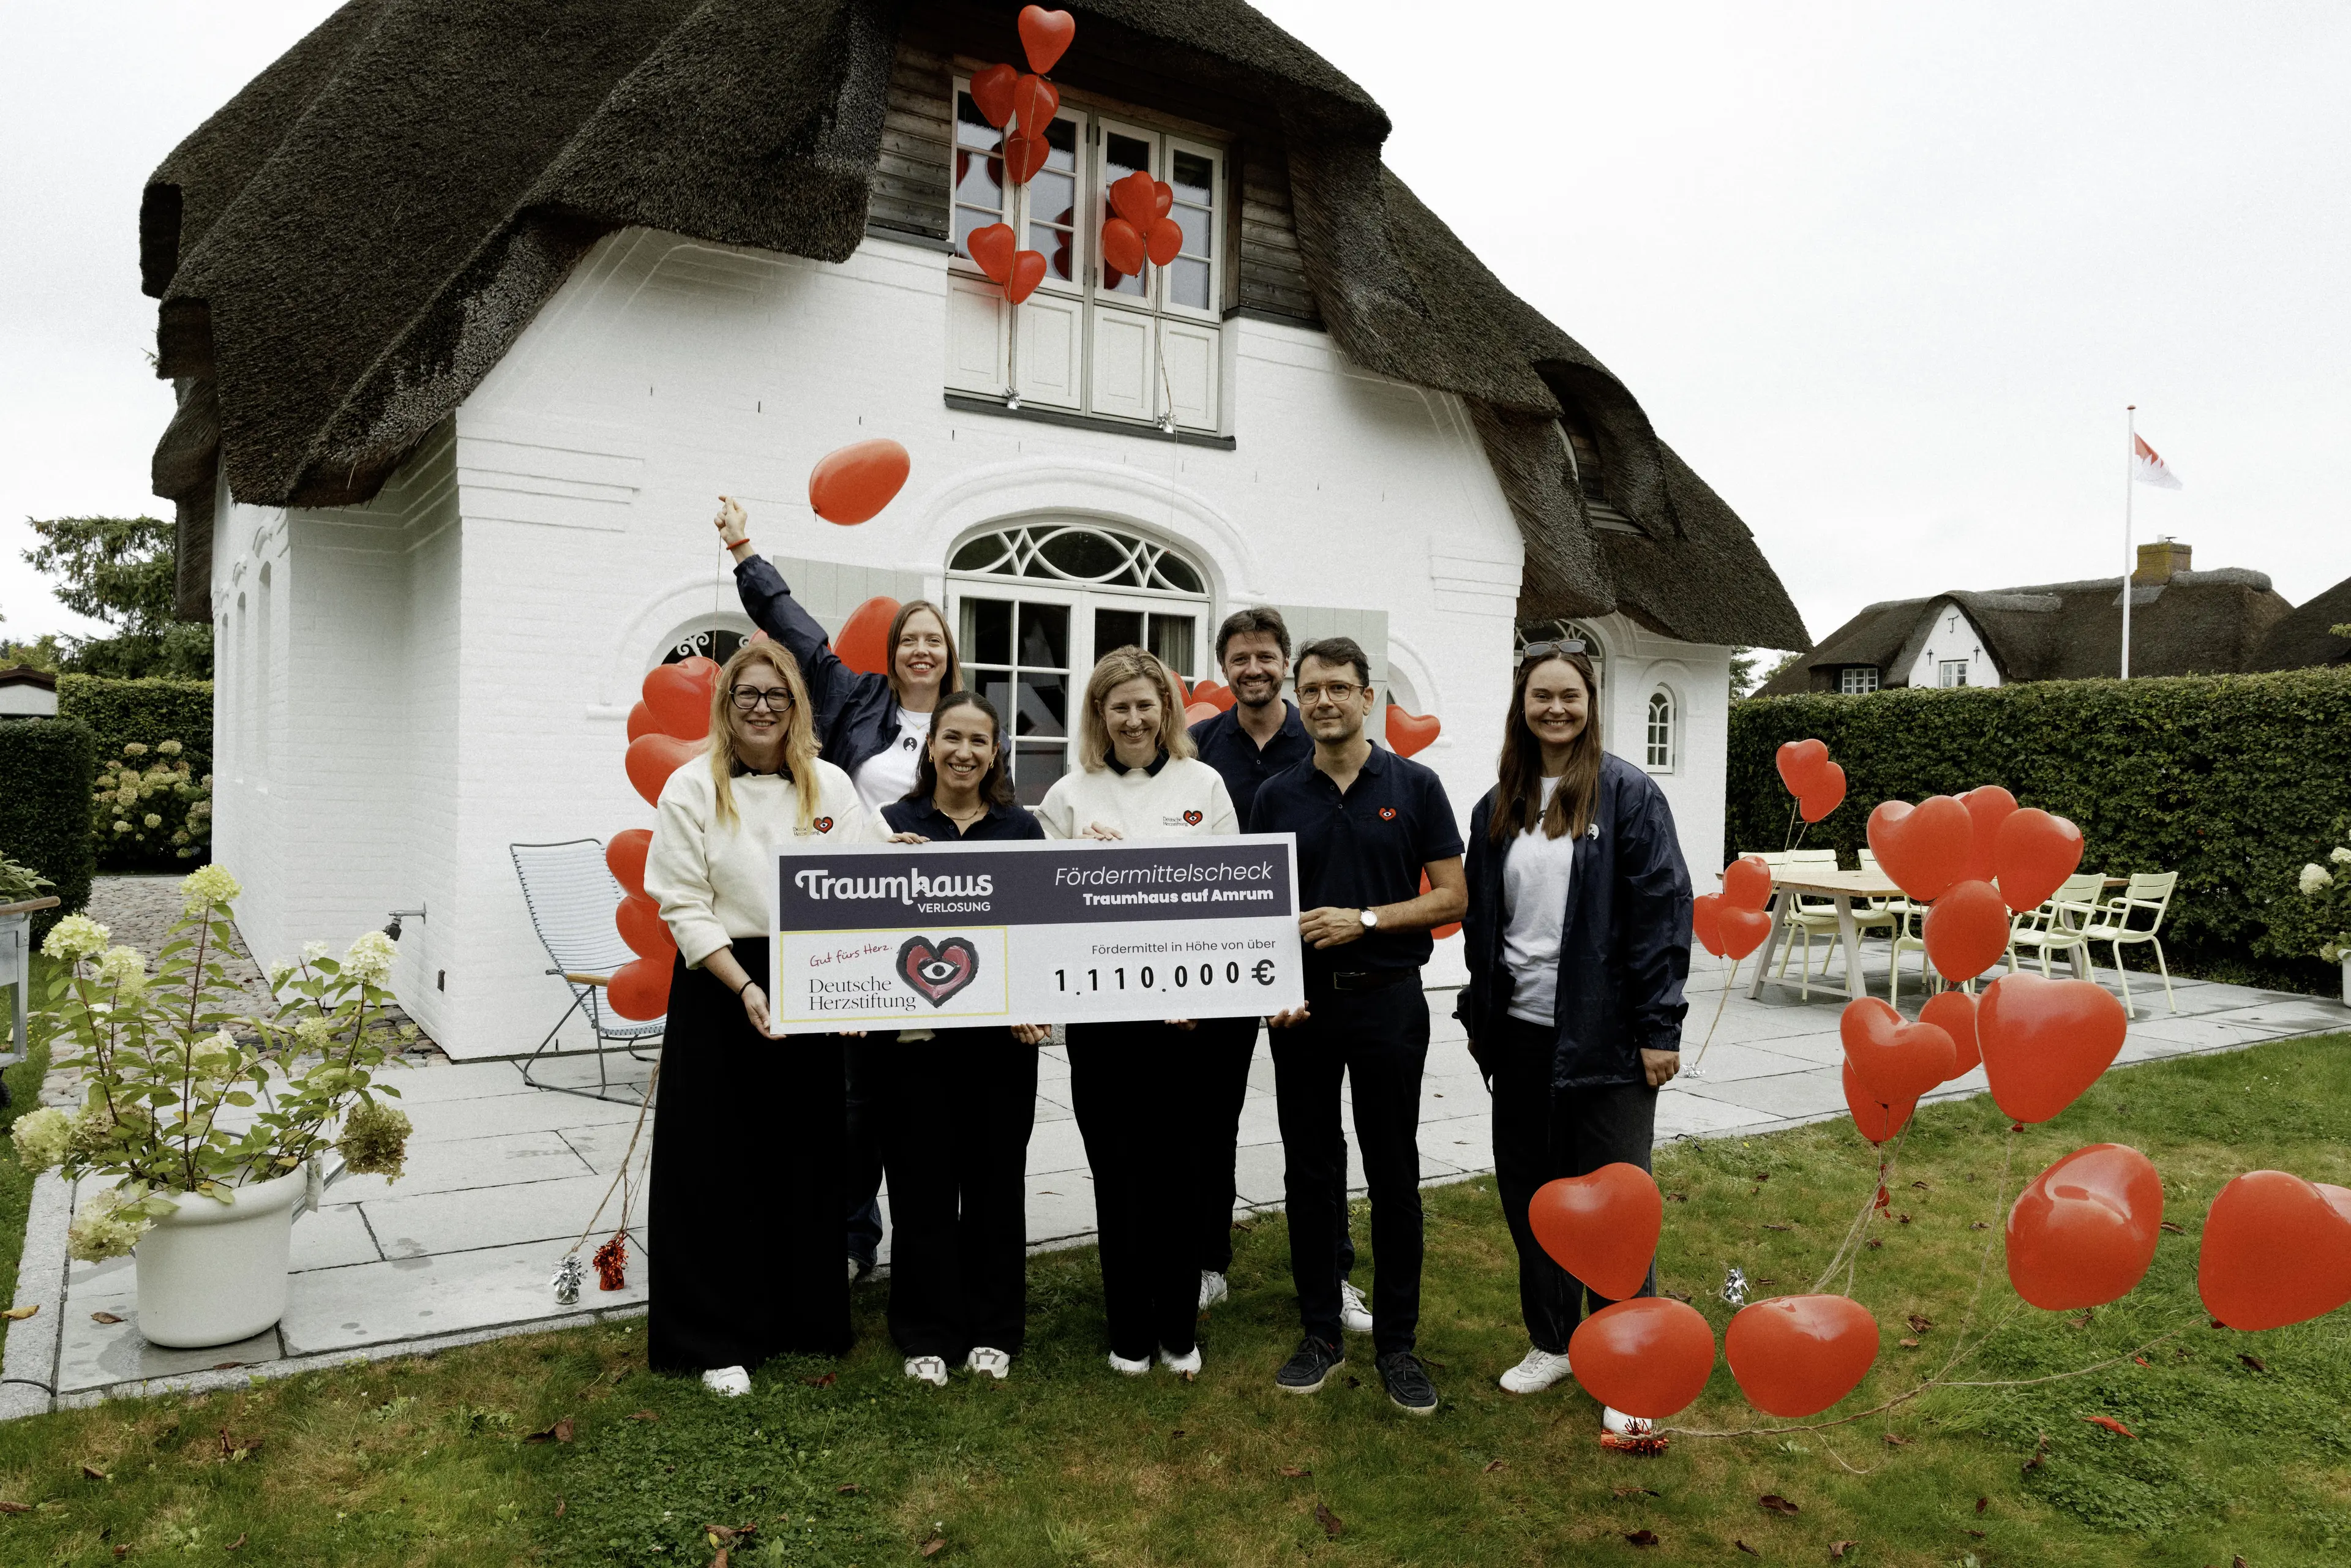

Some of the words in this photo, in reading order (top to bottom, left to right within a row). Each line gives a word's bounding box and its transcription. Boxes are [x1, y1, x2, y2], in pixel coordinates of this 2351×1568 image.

[1056, 861, 1273, 886] Fördermittelscheck
[795, 868, 994, 906] Traumhaus
[1083, 891, 1179, 906] Traumhaus
[1181, 888, 1209, 902] auf
[1210, 888, 1273, 902] Amrum
[917, 901, 991, 913] VERLOSUNG
[810, 952, 832, 967] Gut
[836, 950, 860, 963] fürs
[864, 943, 893, 955] Herz.
[1092, 942, 1168, 955] Fördermittel
[1171, 942, 1182, 951] in
[1186, 940, 1218, 951] Höhe
[1221, 941, 1244, 950] von
[1248, 939, 1276, 950] über
[809, 976, 891, 994] Deutsche
[1055, 961, 1239, 996] 1.110.000
[1251, 959, 1275, 986] €
[809, 992, 917, 1011] Herzstiftung
